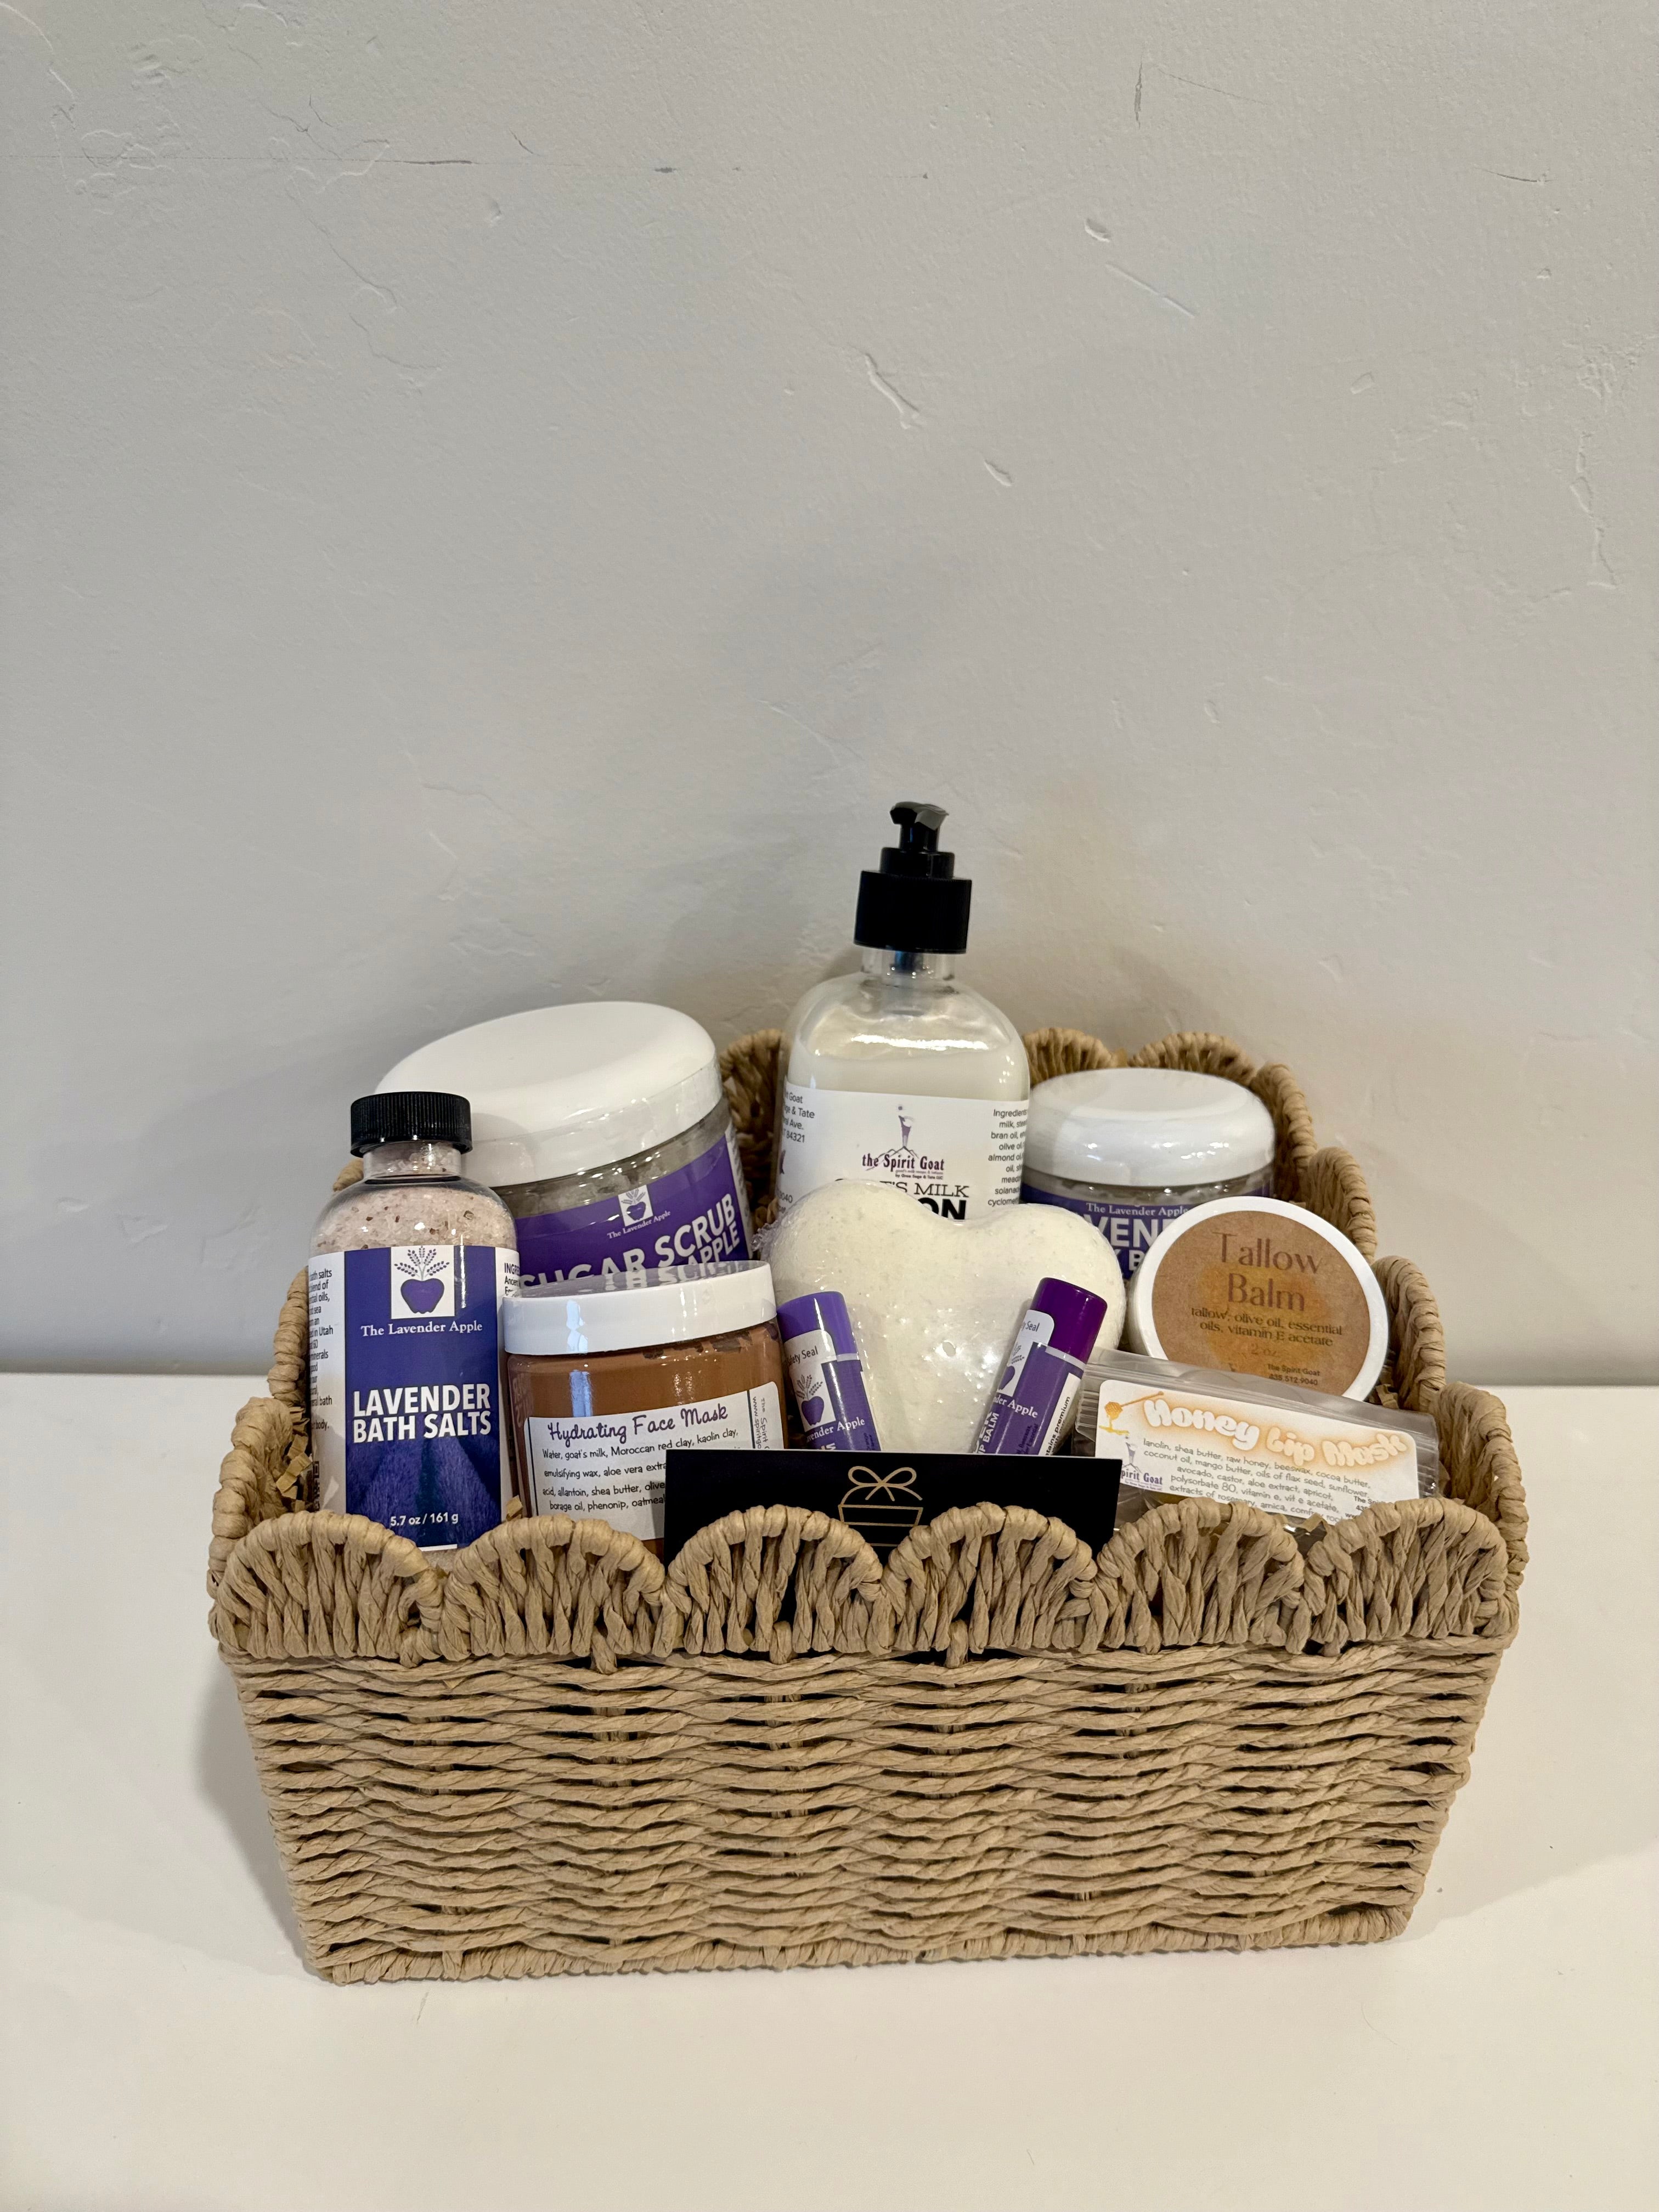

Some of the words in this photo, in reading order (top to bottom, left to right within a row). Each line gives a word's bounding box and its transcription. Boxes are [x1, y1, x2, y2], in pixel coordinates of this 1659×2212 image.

[798, 1108, 815, 1118] Tate
[991, 1131, 1008, 1139] bran
[862, 1153, 879, 1166] the
[883, 1154, 915, 1172] Spirit
[920, 1156, 944, 1171] Goat
[914, 1183, 969, 1198] MILK
[1086, 1202, 1105, 1214] The
[1109, 1205, 1155, 1216] Lavender
[1158, 1206, 1189, 1217] Apple
[607, 1231, 622, 1239] The
[623, 1218, 652, 1234] Lavender
[653, 1210, 672, 1223] Apple
[654, 1193, 736, 1268] SCRUB
[1212, 1231, 1323, 1274] Tallow
[318, 1268, 332, 1279] salts
[322, 1279, 329, 1290] of
[1228, 1272, 1305, 1312] Balm
[319, 1325, 334, 1336] Utah
[360, 1324, 385, 1337] The
[388, 1321, 447, 1335] Lavender
[449, 1319, 483, 1334] Apple
[1025, 1321, 1040, 1332] Seal
[1235, 1312, 1264, 1326] olive
[1288, 1321, 1342, 1336] essential
[1227, 1324, 1272, 1340] vitamin
[1276, 1331, 1285, 1341] E
[1288, 1334, 1334, 1347] acetate
[802, 1345, 819, 1359] Seal
[1282, 1364, 1301, 1374] Spirit
[1302, 1368, 1321, 1376] Goat
[319, 1395, 332, 1406] bath
[353, 1383, 491, 1417] LAVENDER
[1007, 1399, 1038, 1418] Apple
[837, 1417, 865, 1431] Apple
[1054, 1396, 1070, 1434] premium
[353, 1415, 415, 1443] BATH
[423, 1410, 492, 1439] SALTS
[548, 1422, 627, 1448] Hydrating
[632, 1414, 675, 1435] Face
[680, 1403, 729, 1427] Mask
[982, 1412, 1000, 1443] BALM
[1143, 1398, 1261, 1452] Honey
[1266, 1427, 1315, 1467] Lip
[1322, 1433, 1408, 1467] Mask
[542, 1448, 563, 1459] Water,
[565, 1449, 588, 1461] goat's
[590, 1448, 608, 1458] milk,
[611, 1444, 655, 1457] Moroccan
[658, 1440, 673, 1451] red
[675, 1438, 695, 1449] clay,
[697, 1433, 720, 1444] kaolin
[544, 1468, 580, 1480] emulsifying
[603, 1466, 621, 1477] aloe
[624, 1466, 643, 1475] vera
[646, 1462, 667, 1471] extra
[1144, 1450, 1177, 1461] coconut
[1195, 1460, 1223, 1471] mango
[1256, 1470, 1271, 1479] oils
[1273, 1471, 1283, 1480] of
[1285, 1473, 1301, 1482] flax
[1175, 1444, 1193, 1454] shea
[1227, 1455, 1241, 1464] raw
[1316, 1470, 1341, 1482] cocoa
[1121, 1469, 1139, 1480] pirit
[1143, 1472, 1163, 1485] Goat
[1248, 1479, 1265, 1488] aloe
[543, 1486, 556, 1497] acid,
[558, 1487, 589, 1497] allantoin,
[591, 1486, 611, 1497] shea
[613, 1484, 642, 1495] butter,
[645, 1480, 665, 1491] olive
[1169, 1485, 1203, 1496] extracts
[1171, 1474, 1220, 1490] polysorbate
[1241, 1488, 1271, 1499] vitamin
[550, 1500, 572, 1513] borage
[574, 1501, 585, 1511] oil,
[588, 1500, 629, 1513] phenonip,
[390, 1515, 407, 1526] 5.7
[408, 1516, 421, 1525] oz
[430, 1511, 448, 1523] 161
[452, 1513, 459, 1525] g
